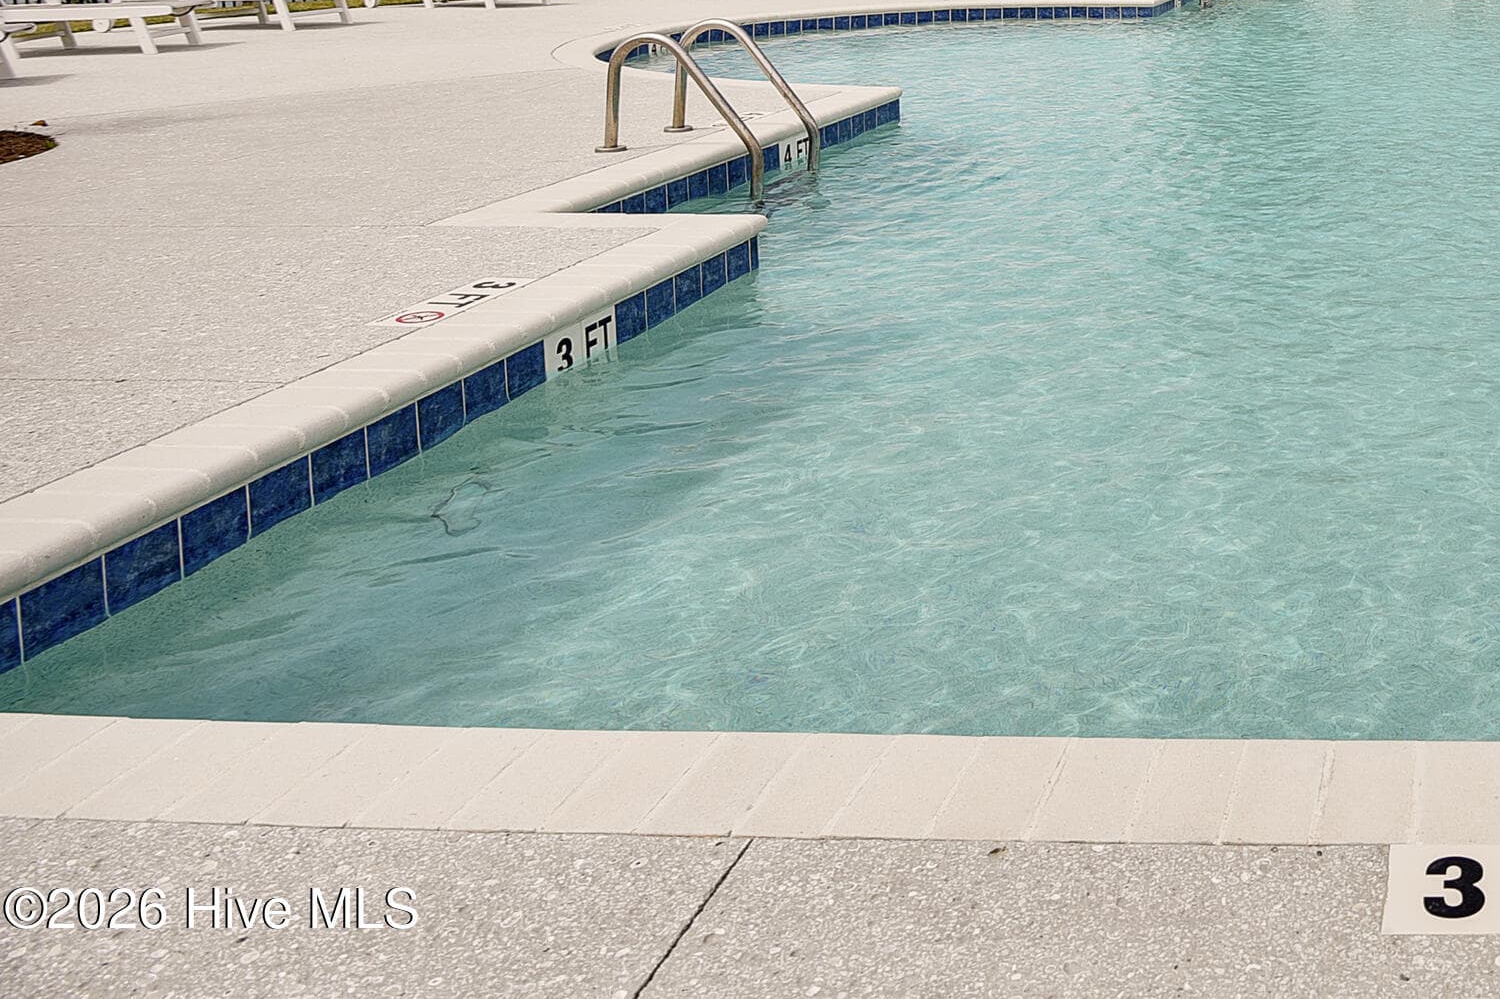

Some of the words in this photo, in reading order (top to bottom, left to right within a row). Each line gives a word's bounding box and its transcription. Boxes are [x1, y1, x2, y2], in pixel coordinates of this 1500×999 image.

[784, 144, 792, 163] 4
[473, 281, 516, 289] 3
[427, 293, 490, 308] FT
[555, 337, 574, 372] 3
[585, 315, 612, 367] FT
[1423, 856, 1485, 918] 3
